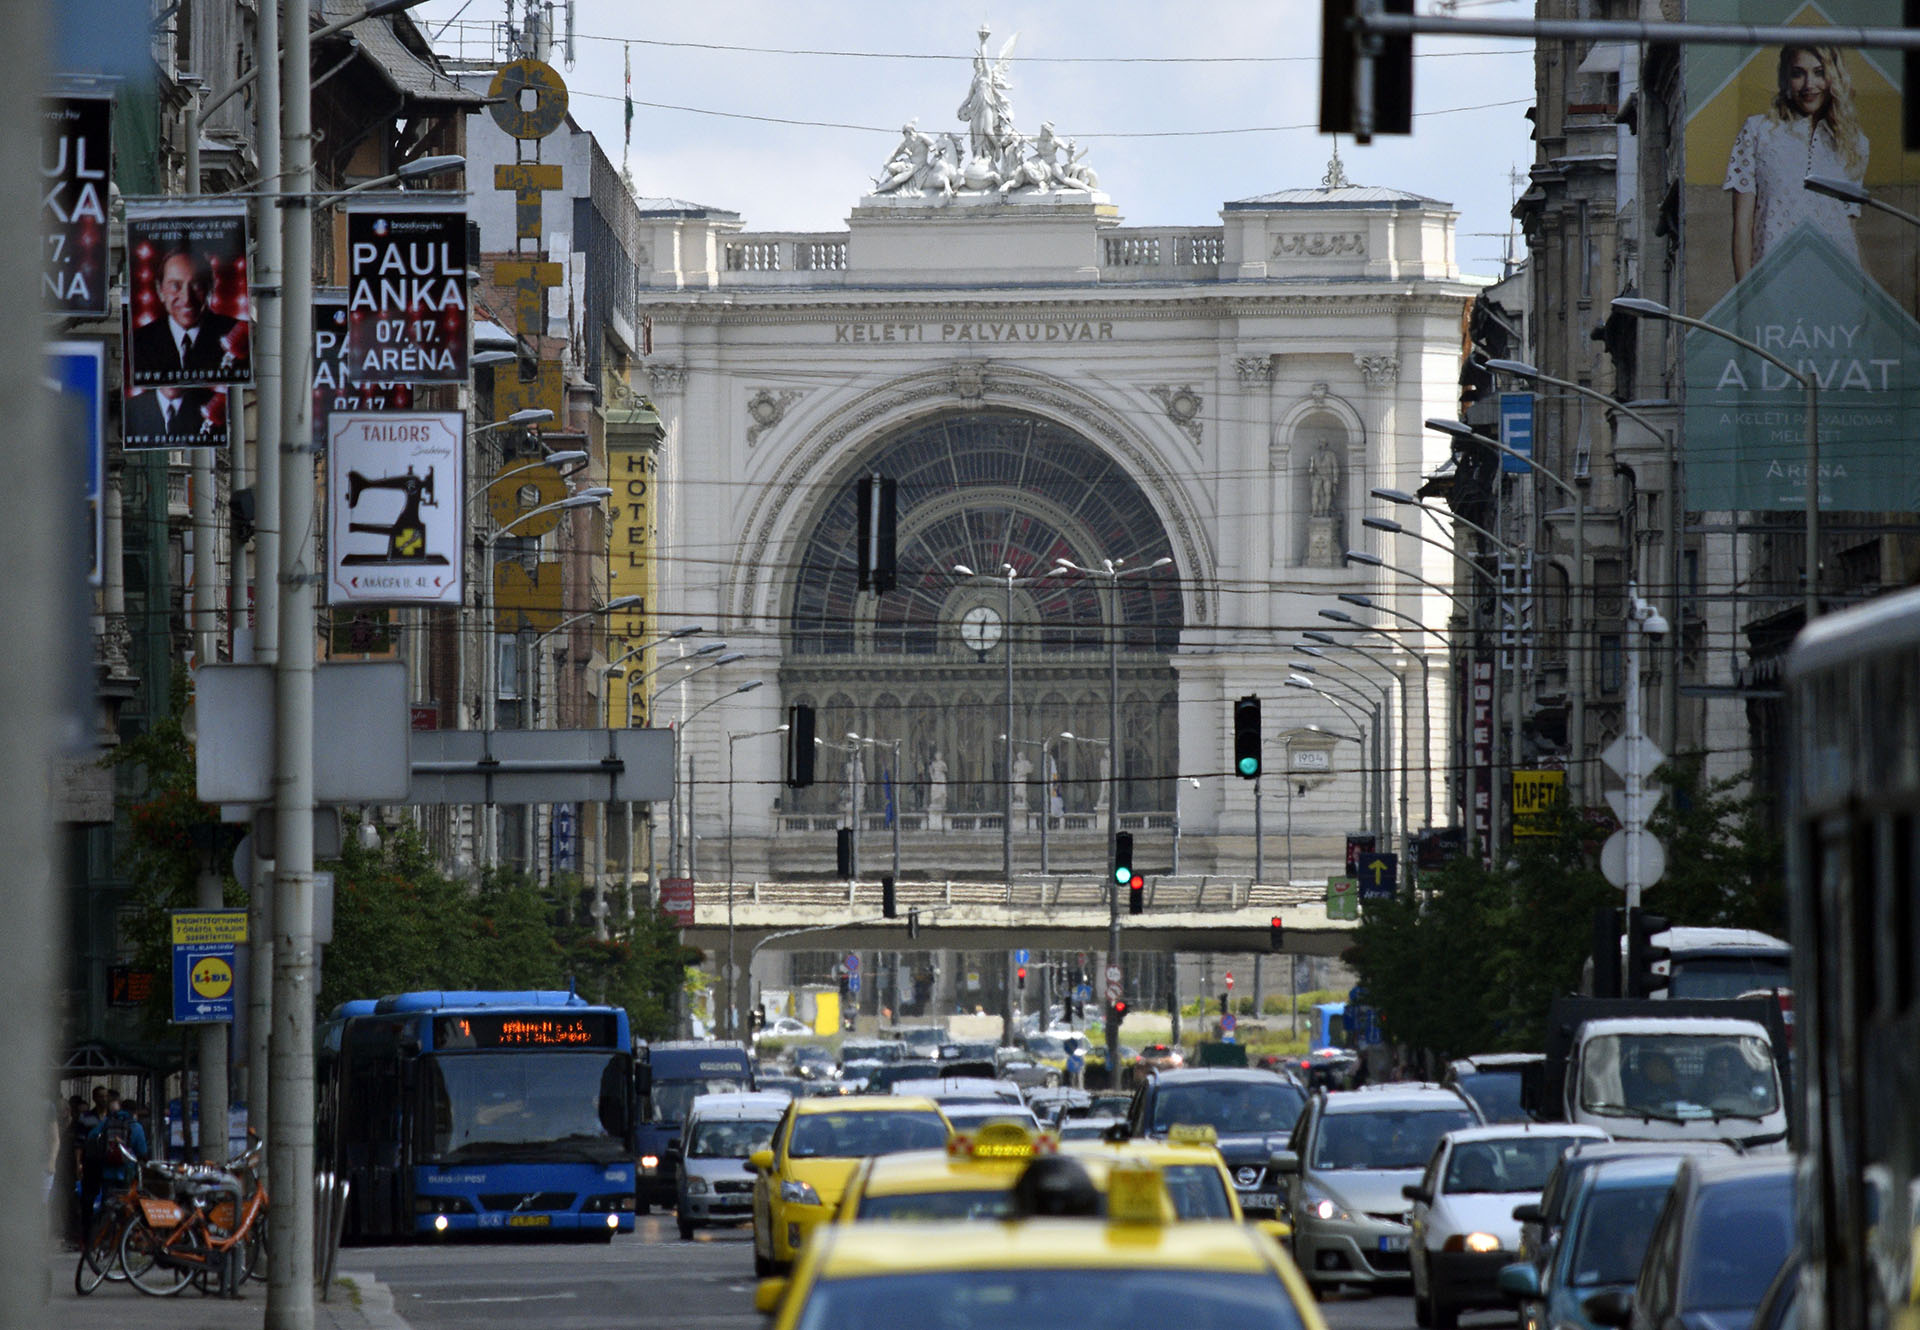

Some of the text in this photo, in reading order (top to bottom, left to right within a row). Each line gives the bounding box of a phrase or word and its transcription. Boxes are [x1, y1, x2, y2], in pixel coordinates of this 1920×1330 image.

[353, 242, 464, 276] PAUL
[351, 278, 465, 312] ANKA
[835, 322, 1114, 342] KELETI PÁLYAUDVAR
[1755, 318, 1861, 349] IRÁNY
[362, 344, 456, 371] ARÉNA
[1716, 359, 1900, 393] A DIVAT
[361, 425, 430, 442] TAILORS
[627, 456, 647, 567] HOTEL
[1475, 663, 1491, 767] HOTEL
[1298, 753, 1323, 762] 1904
